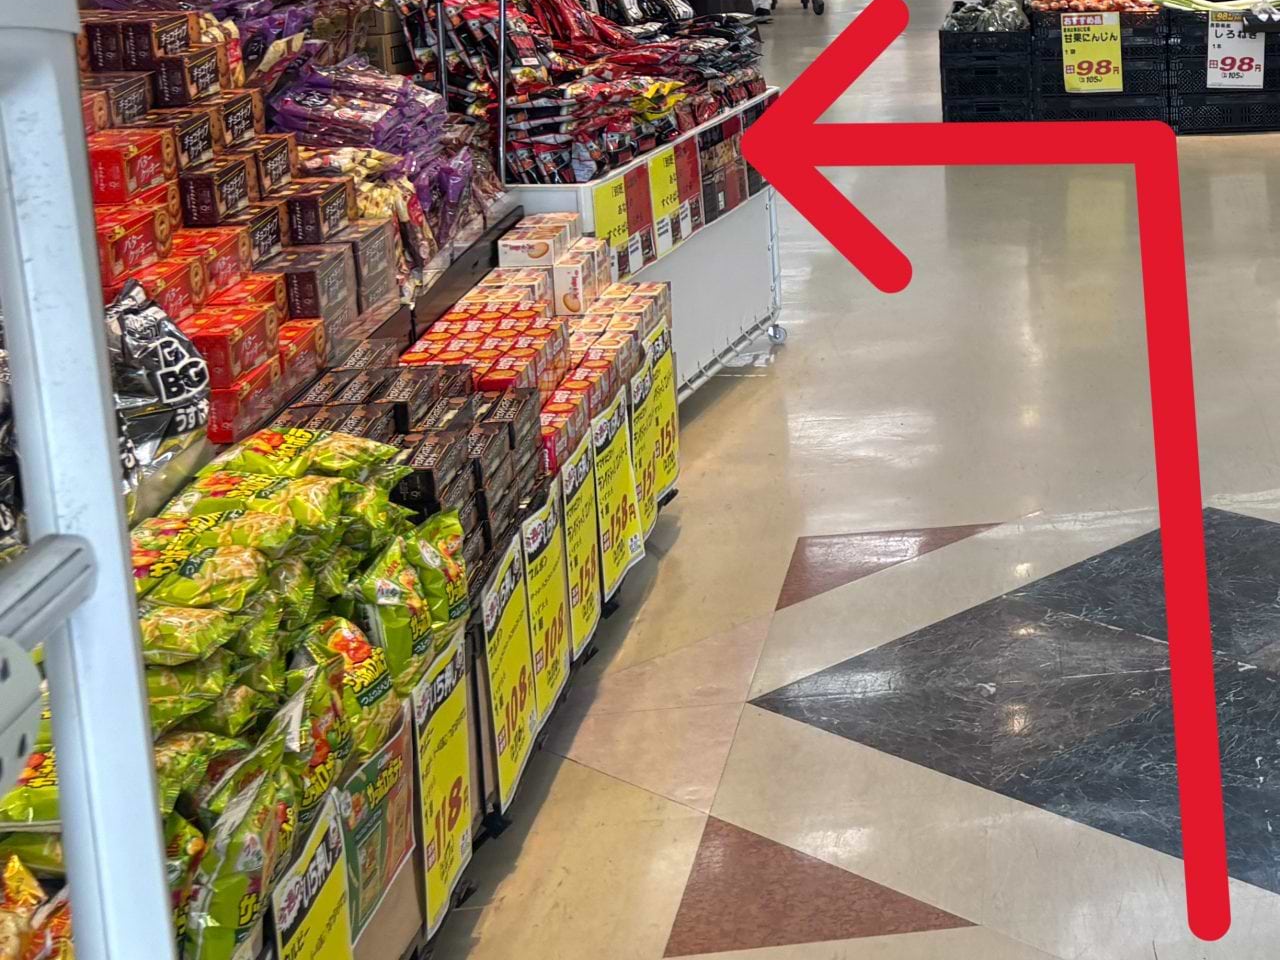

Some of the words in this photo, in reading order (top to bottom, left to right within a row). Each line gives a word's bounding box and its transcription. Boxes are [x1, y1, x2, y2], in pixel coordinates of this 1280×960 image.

[1063, 15, 1102, 25] おすすめ品
